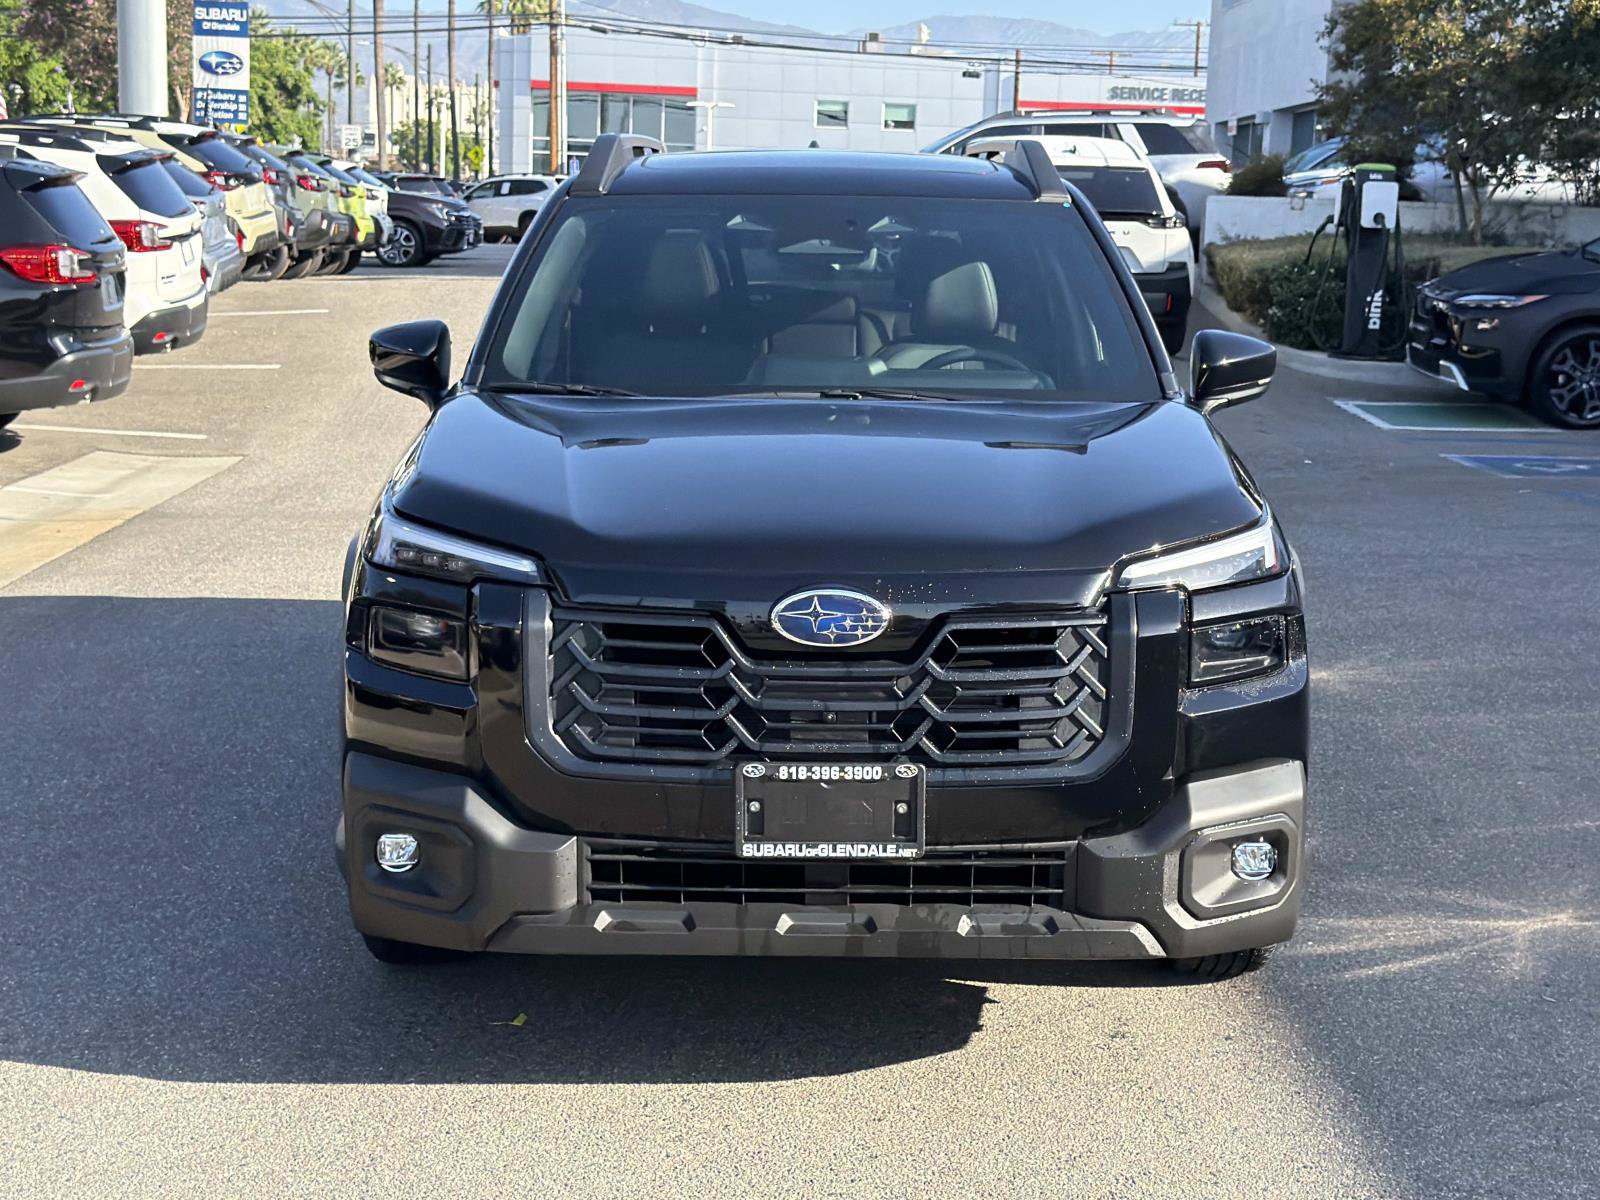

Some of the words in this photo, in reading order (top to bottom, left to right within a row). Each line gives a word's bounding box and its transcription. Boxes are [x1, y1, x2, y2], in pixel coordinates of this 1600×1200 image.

[195, 7, 247, 22] SUBARU
[1109, 86, 1168, 101] SERVICE
[1171, 88, 1207, 102] RECE
[344, 137, 359, 147] 25
[778, 765, 883, 780] 818-396-3900
